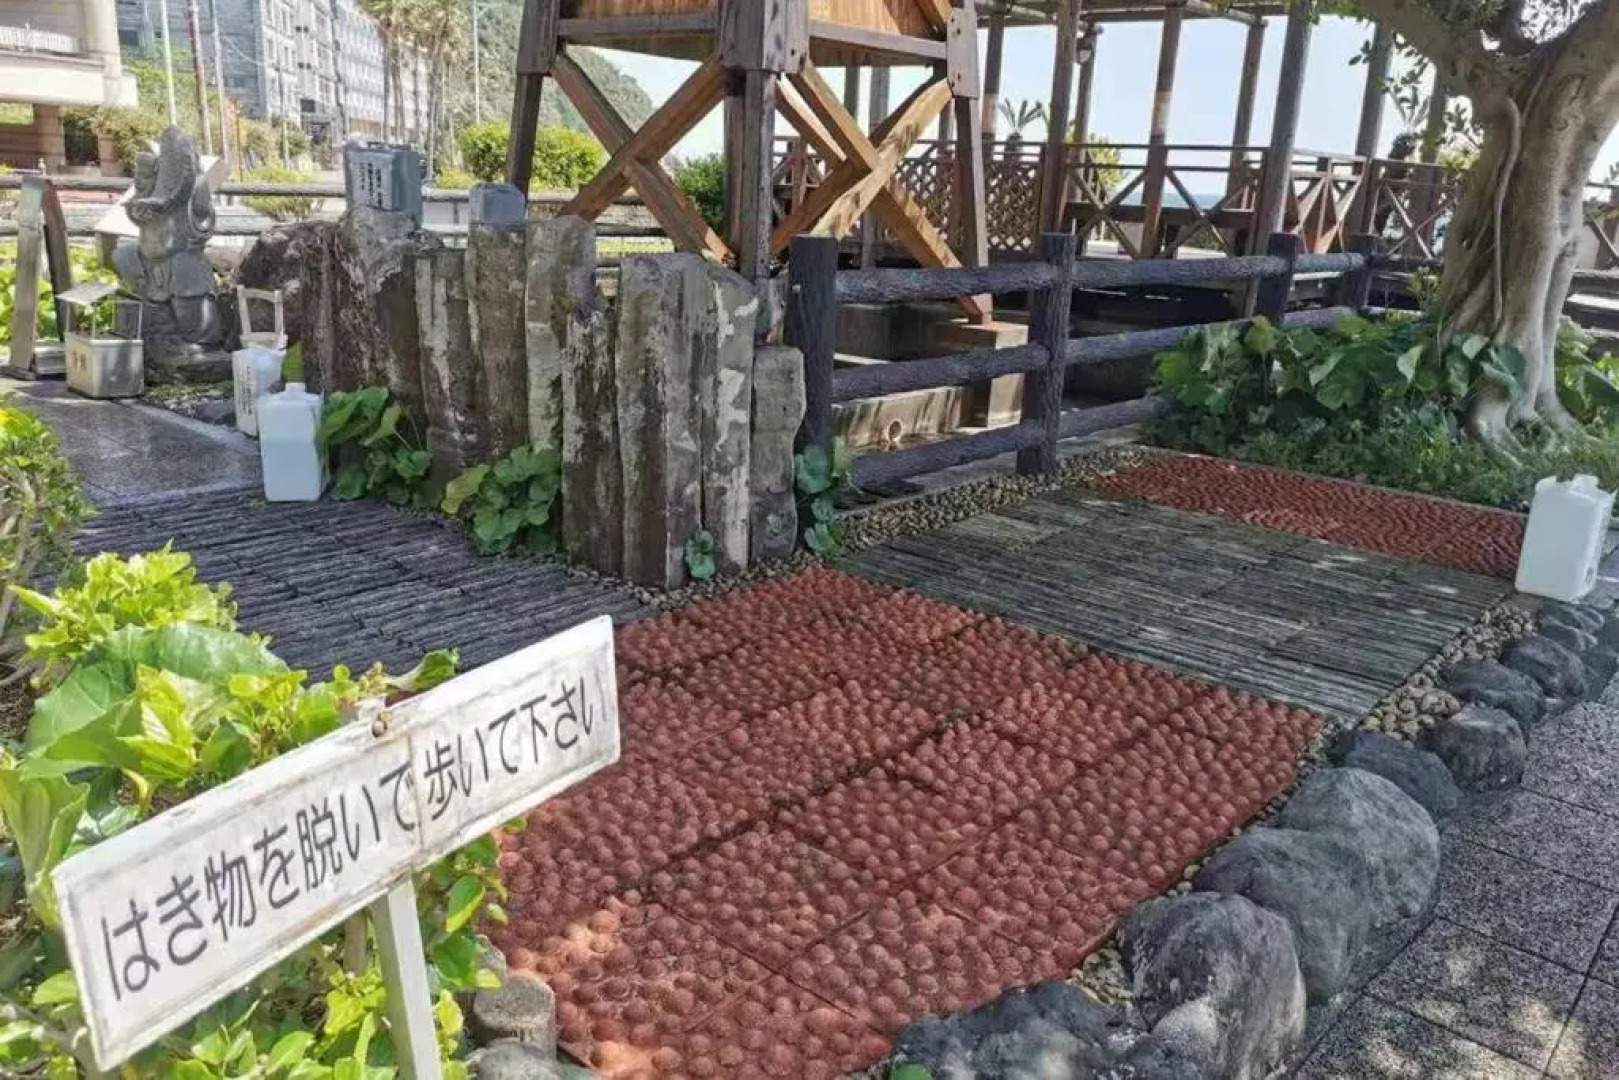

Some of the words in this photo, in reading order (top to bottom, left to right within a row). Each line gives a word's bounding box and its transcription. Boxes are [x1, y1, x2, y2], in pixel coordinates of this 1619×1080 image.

[101, 673, 607, 1002] はき物を脱いで歩いて下さい
